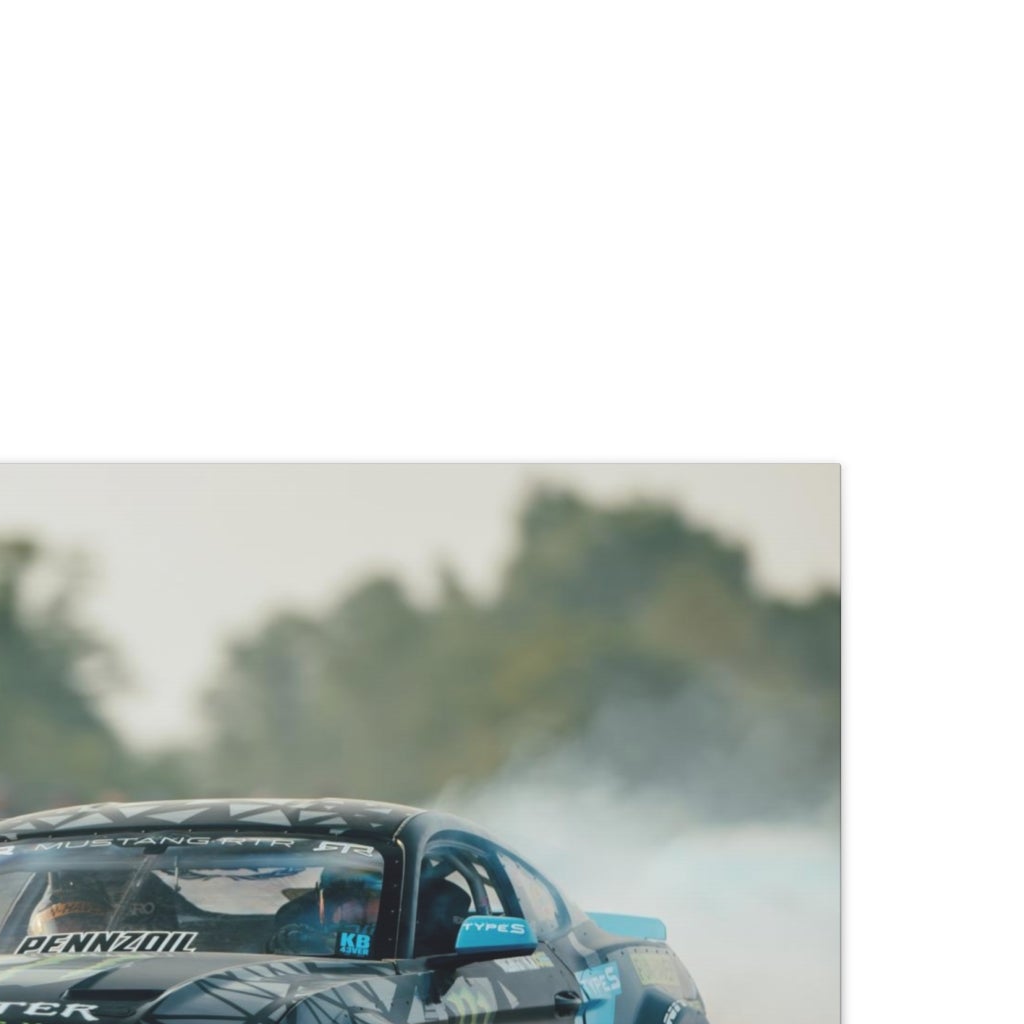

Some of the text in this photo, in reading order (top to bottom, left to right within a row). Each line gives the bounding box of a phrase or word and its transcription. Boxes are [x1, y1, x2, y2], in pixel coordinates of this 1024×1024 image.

[34, 836, 211, 851] MUSTANG
[15, 931, 199, 954] PENNZOIL
[339, 932, 371, 949] KB
